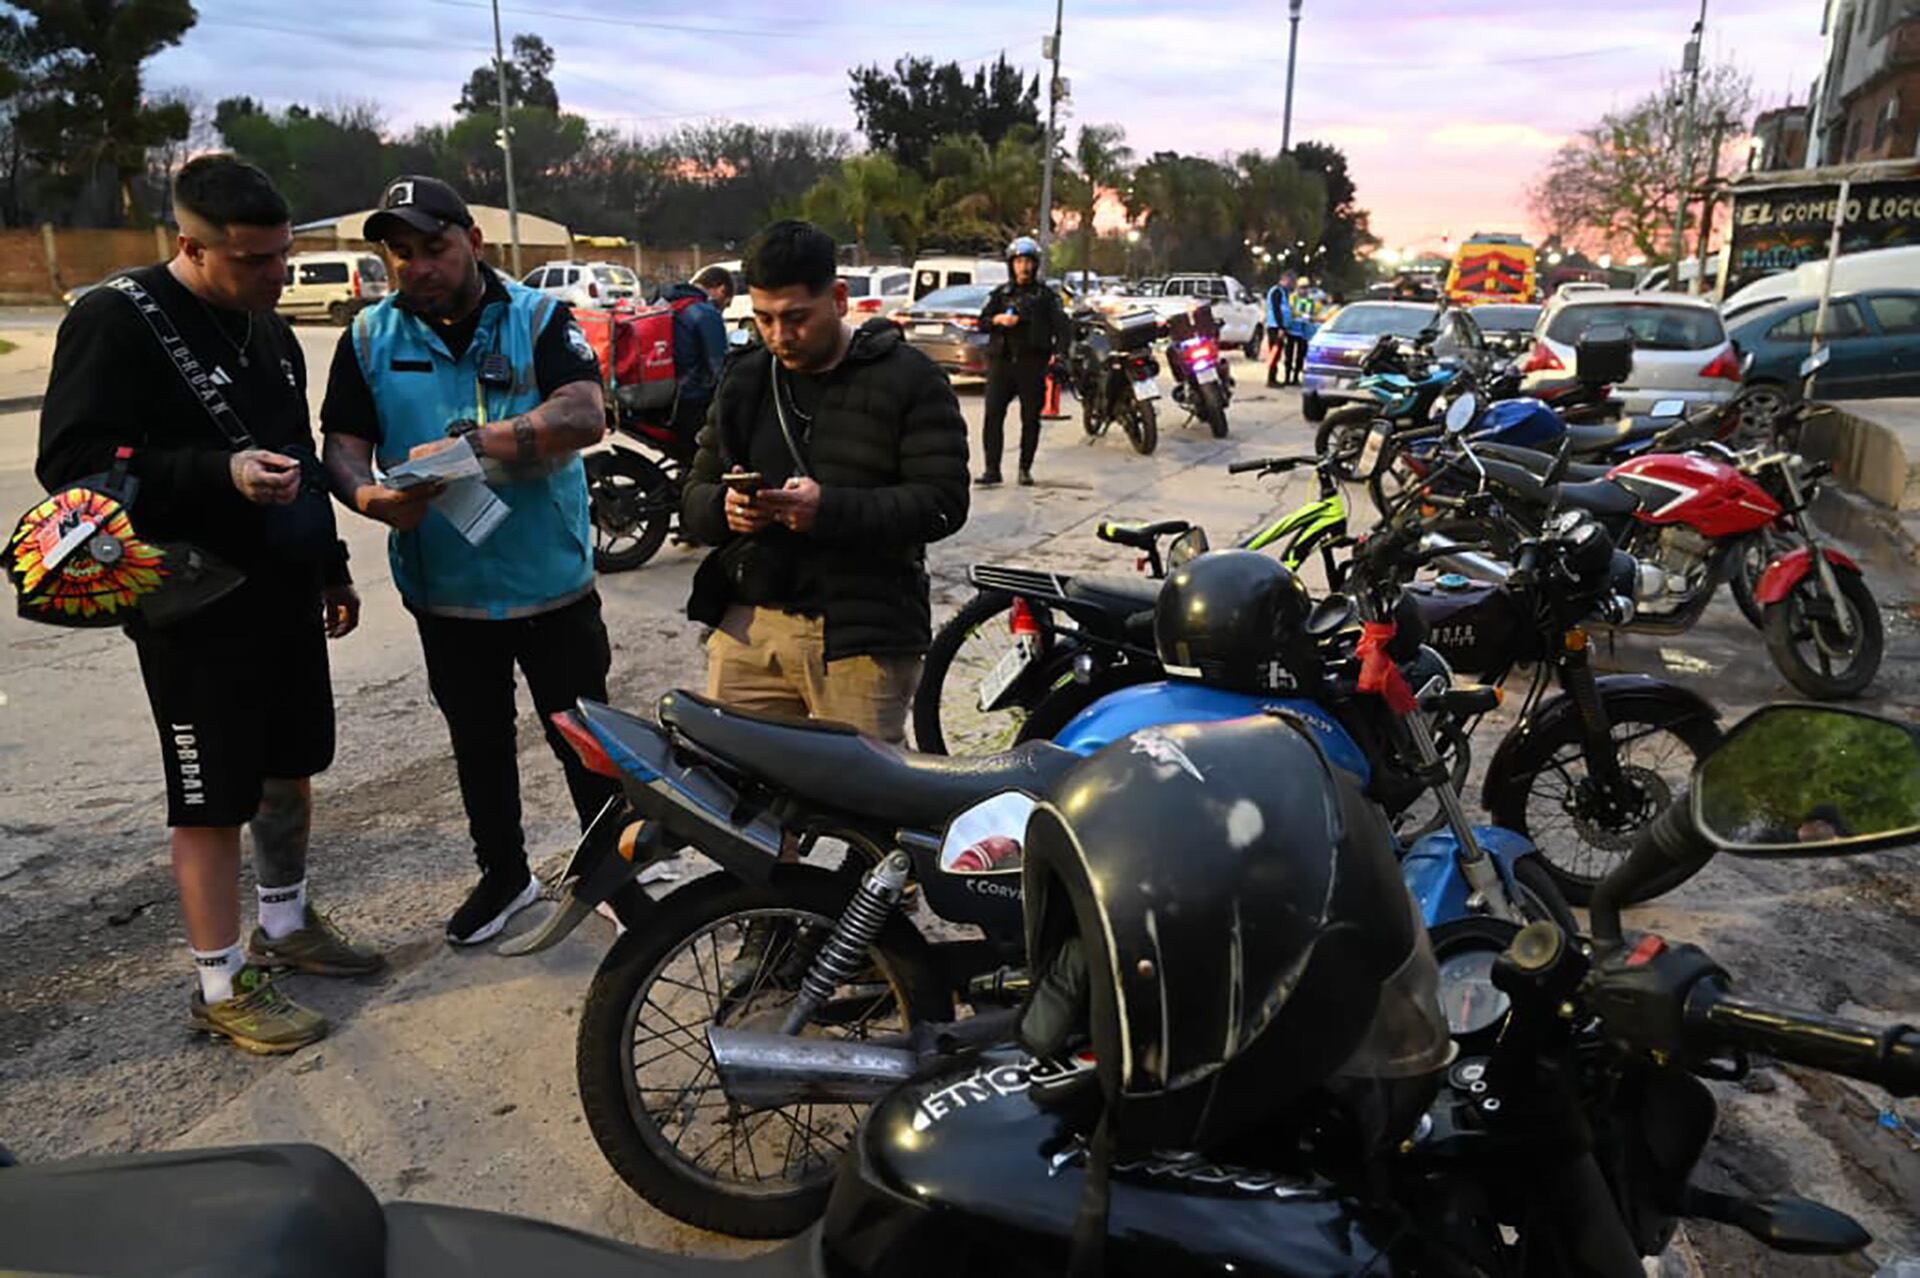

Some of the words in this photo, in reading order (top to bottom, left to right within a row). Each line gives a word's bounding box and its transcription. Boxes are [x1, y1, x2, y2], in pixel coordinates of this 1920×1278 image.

[1741, 203, 1774, 226] EL
[1781, 199, 1861, 223] COMBO
[163, 335, 230, 415] JORDAN
[171, 723, 206, 805] JORDAN
[977, 880, 1023, 899] CORV
